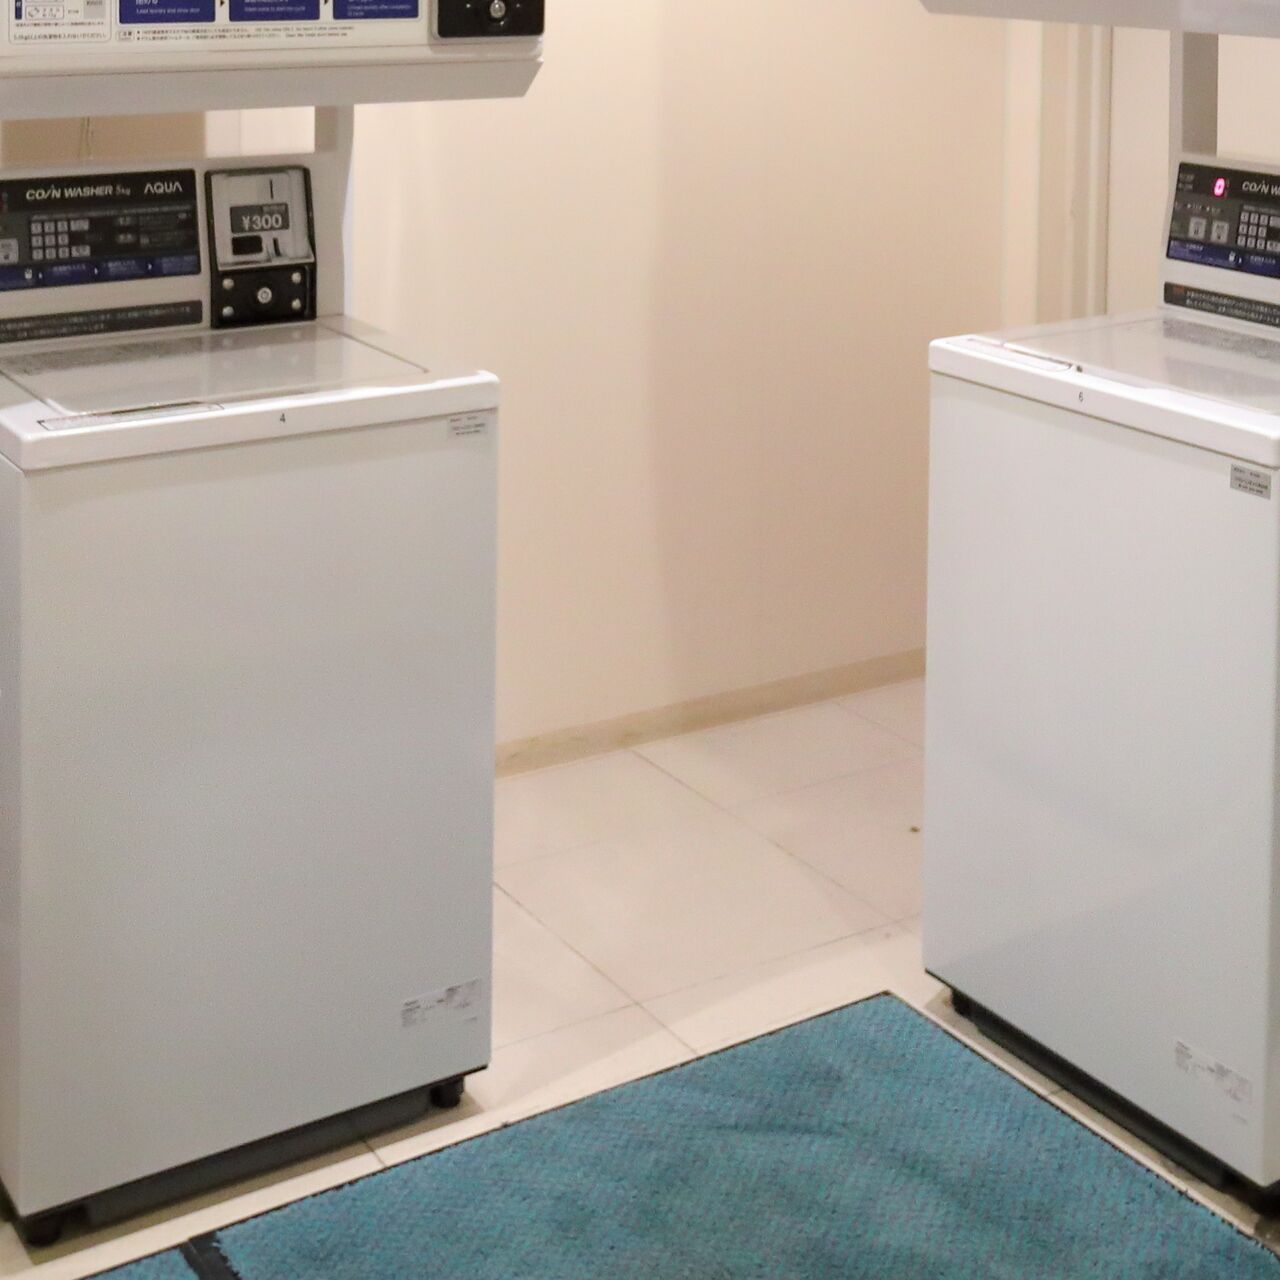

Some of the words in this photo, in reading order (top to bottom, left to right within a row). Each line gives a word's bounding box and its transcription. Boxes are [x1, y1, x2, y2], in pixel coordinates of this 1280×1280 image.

[63, 184, 114, 198] WASHER
[144, 181, 183, 195] AQUA
[1213, 177, 1226, 197] 0
[241, 214, 283, 231] ¥300
